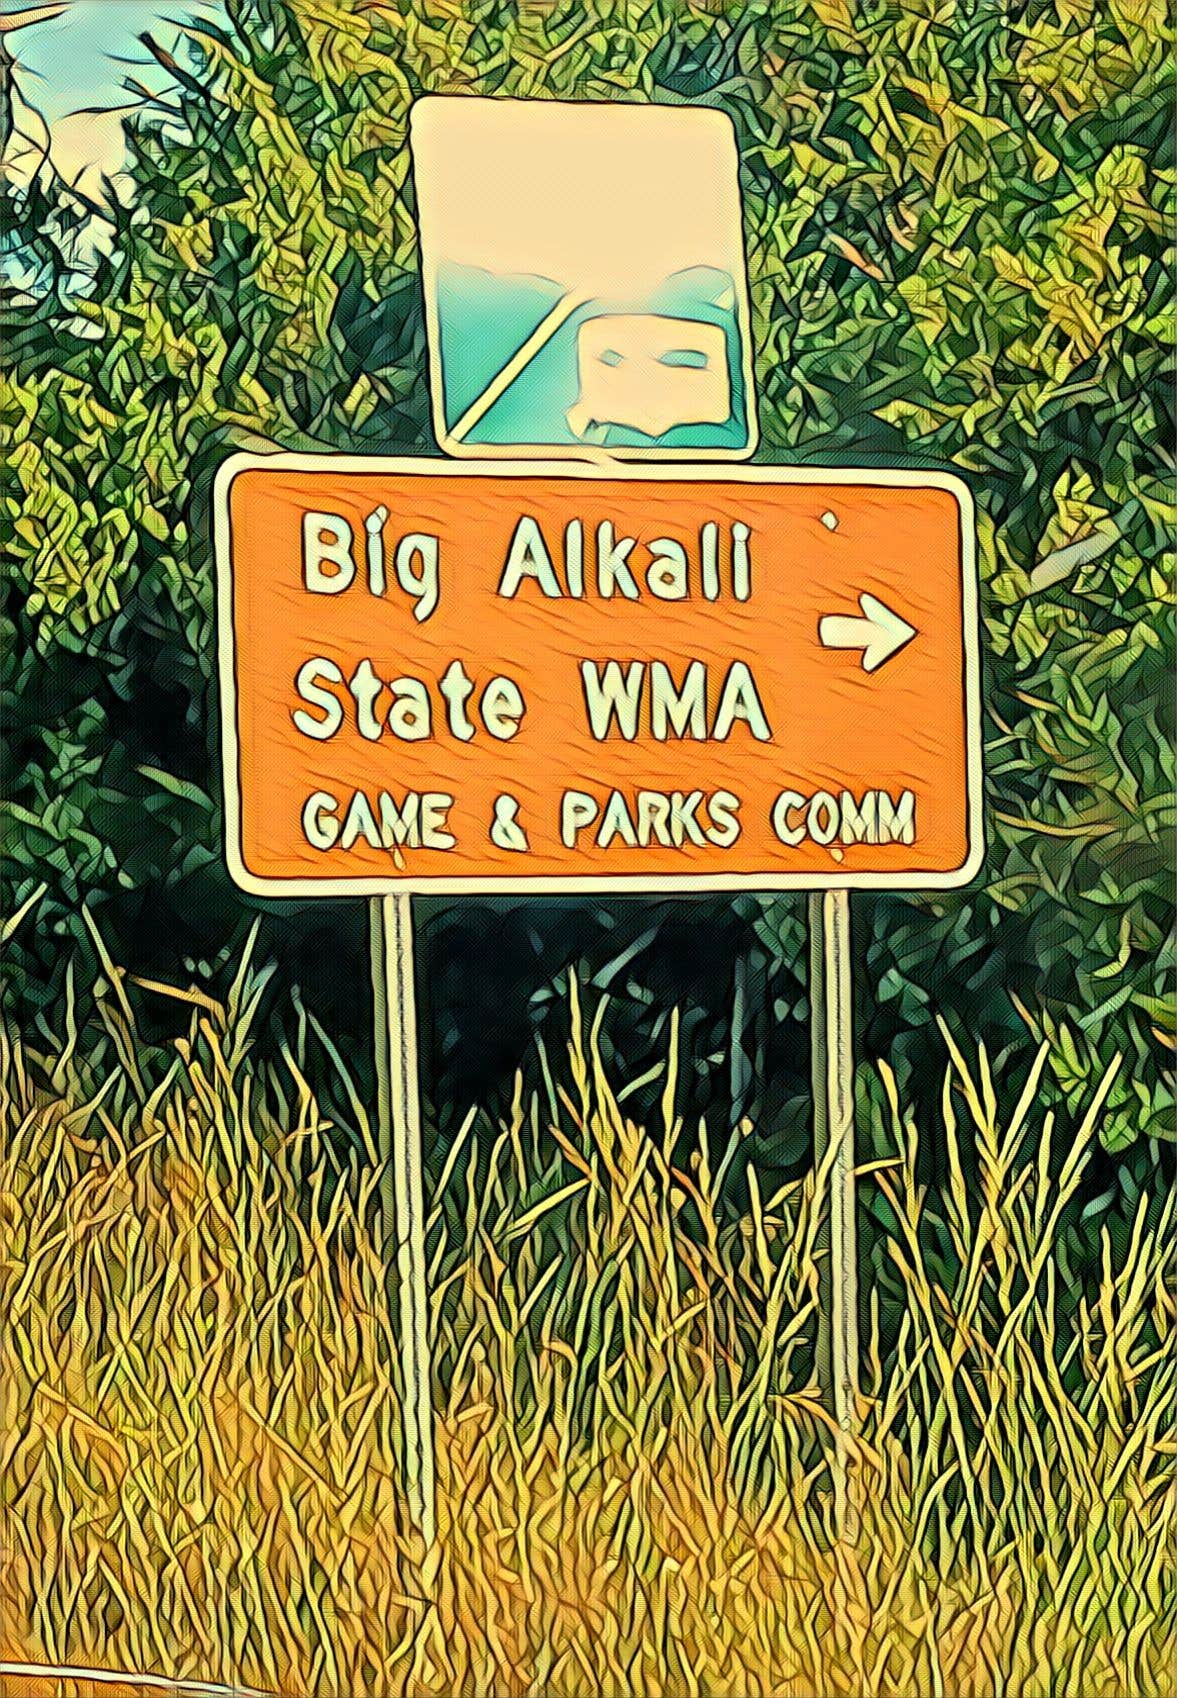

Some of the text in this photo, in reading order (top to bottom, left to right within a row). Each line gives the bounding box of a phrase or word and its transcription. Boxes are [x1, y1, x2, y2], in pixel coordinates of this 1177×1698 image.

[301, 505, 753, 622] Big Alkali
[292, 656, 773, 743] State WMA
[301, 789, 916, 851] GAME & PARKS COMM
